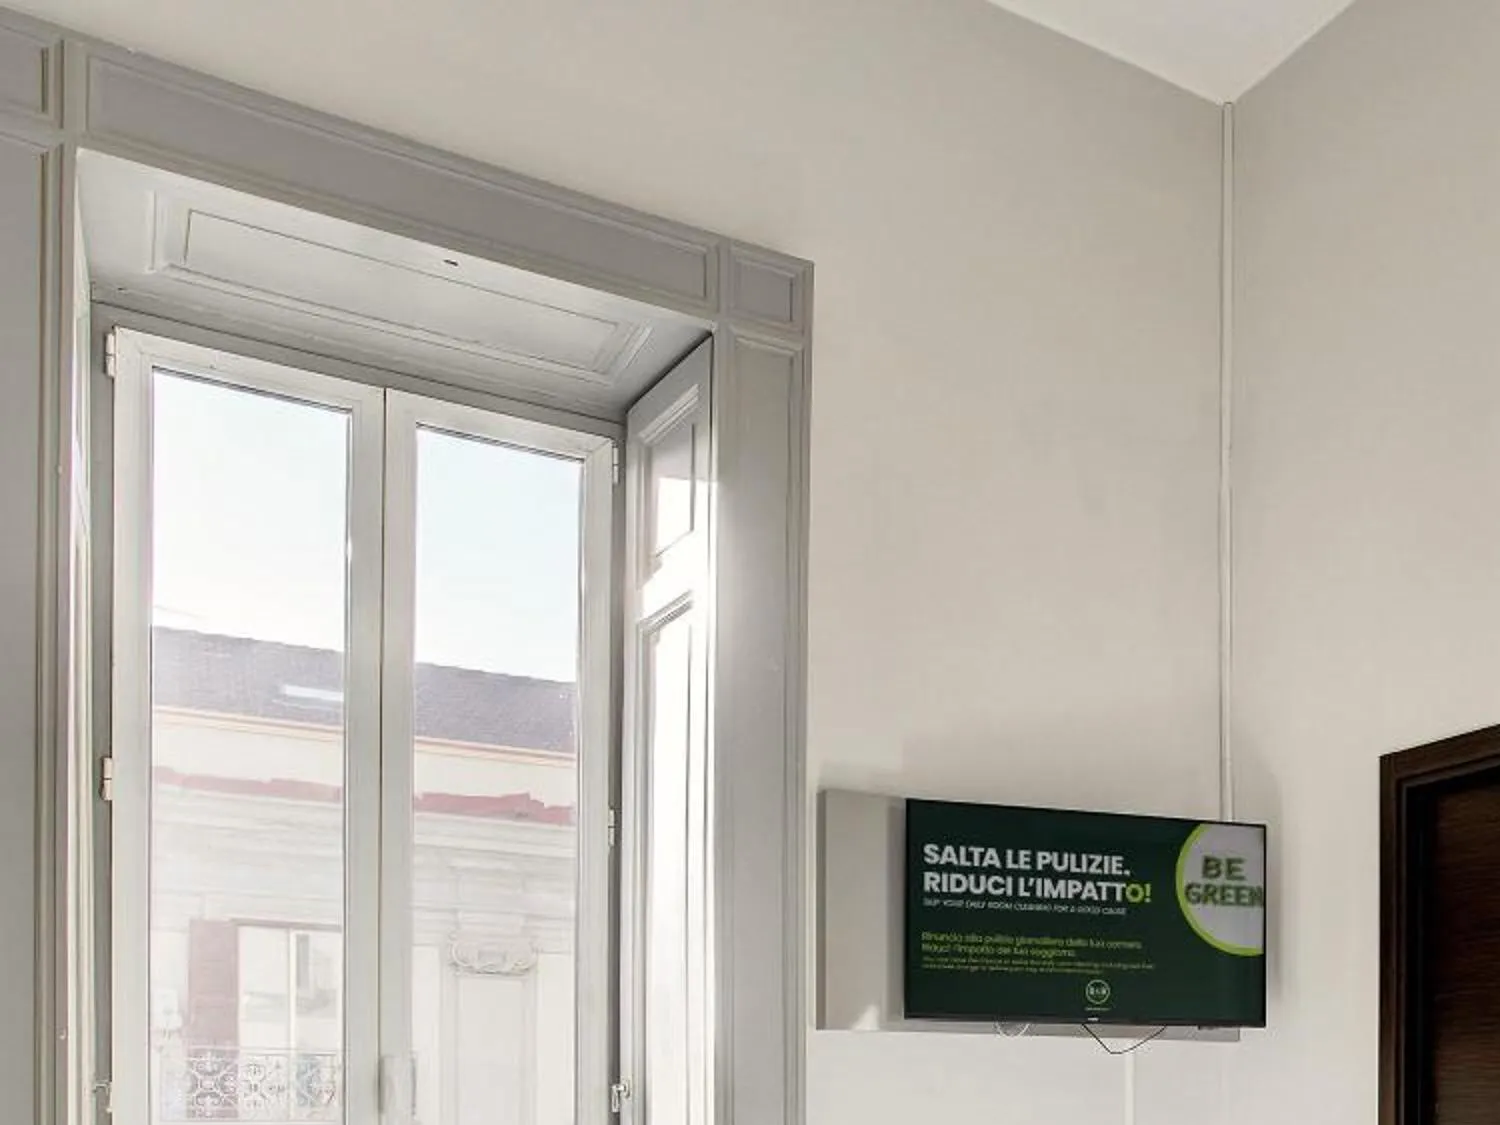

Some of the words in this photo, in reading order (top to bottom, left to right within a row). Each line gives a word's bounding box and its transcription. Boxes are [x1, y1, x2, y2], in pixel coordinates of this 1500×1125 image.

[922, 844, 1001, 868] SALTA
[1006, 849, 1031, 870] LE
[1037, 851, 1131, 876] PULIZIE.
[1202, 855, 1246, 881] BE
[923, 872, 1012, 897] RIDUCI
[1018, 876, 1151, 903] L'IMPATTO!
[1185, 883, 1264, 907] GREEN
